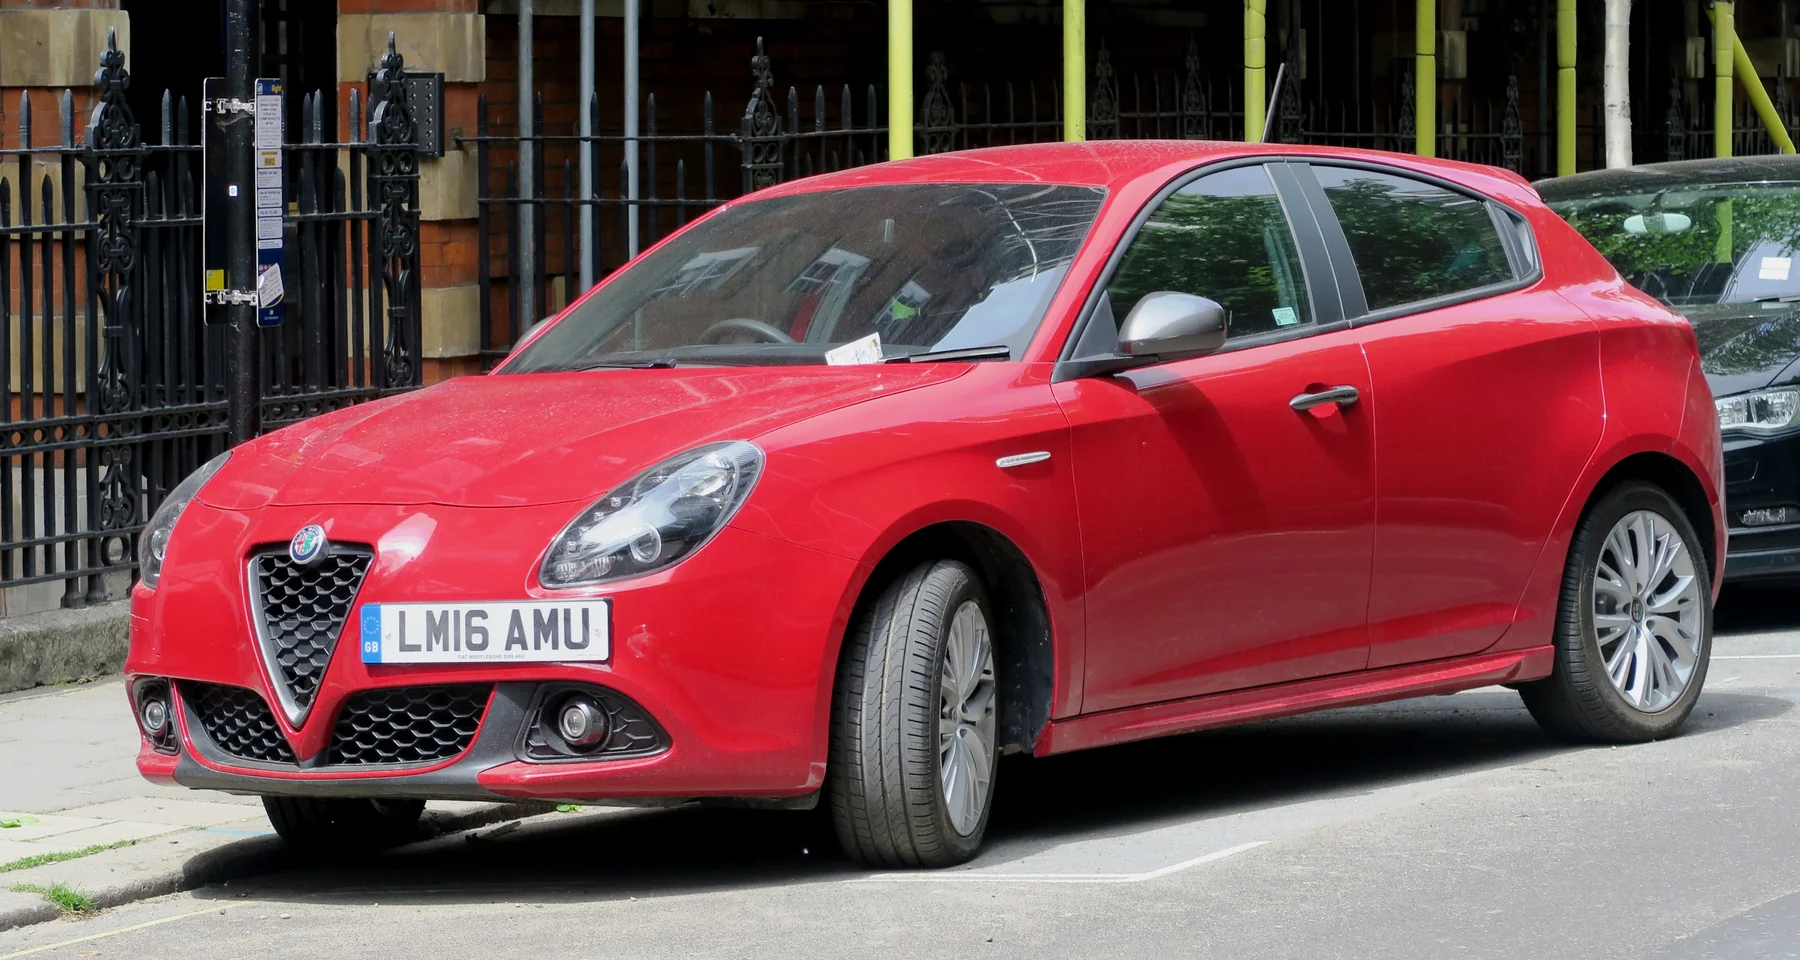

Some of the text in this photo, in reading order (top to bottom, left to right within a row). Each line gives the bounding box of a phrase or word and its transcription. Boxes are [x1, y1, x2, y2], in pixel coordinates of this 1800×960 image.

[398, 608, 590, 652] LM16 AMU
[364, 641, 379, 653] GB
